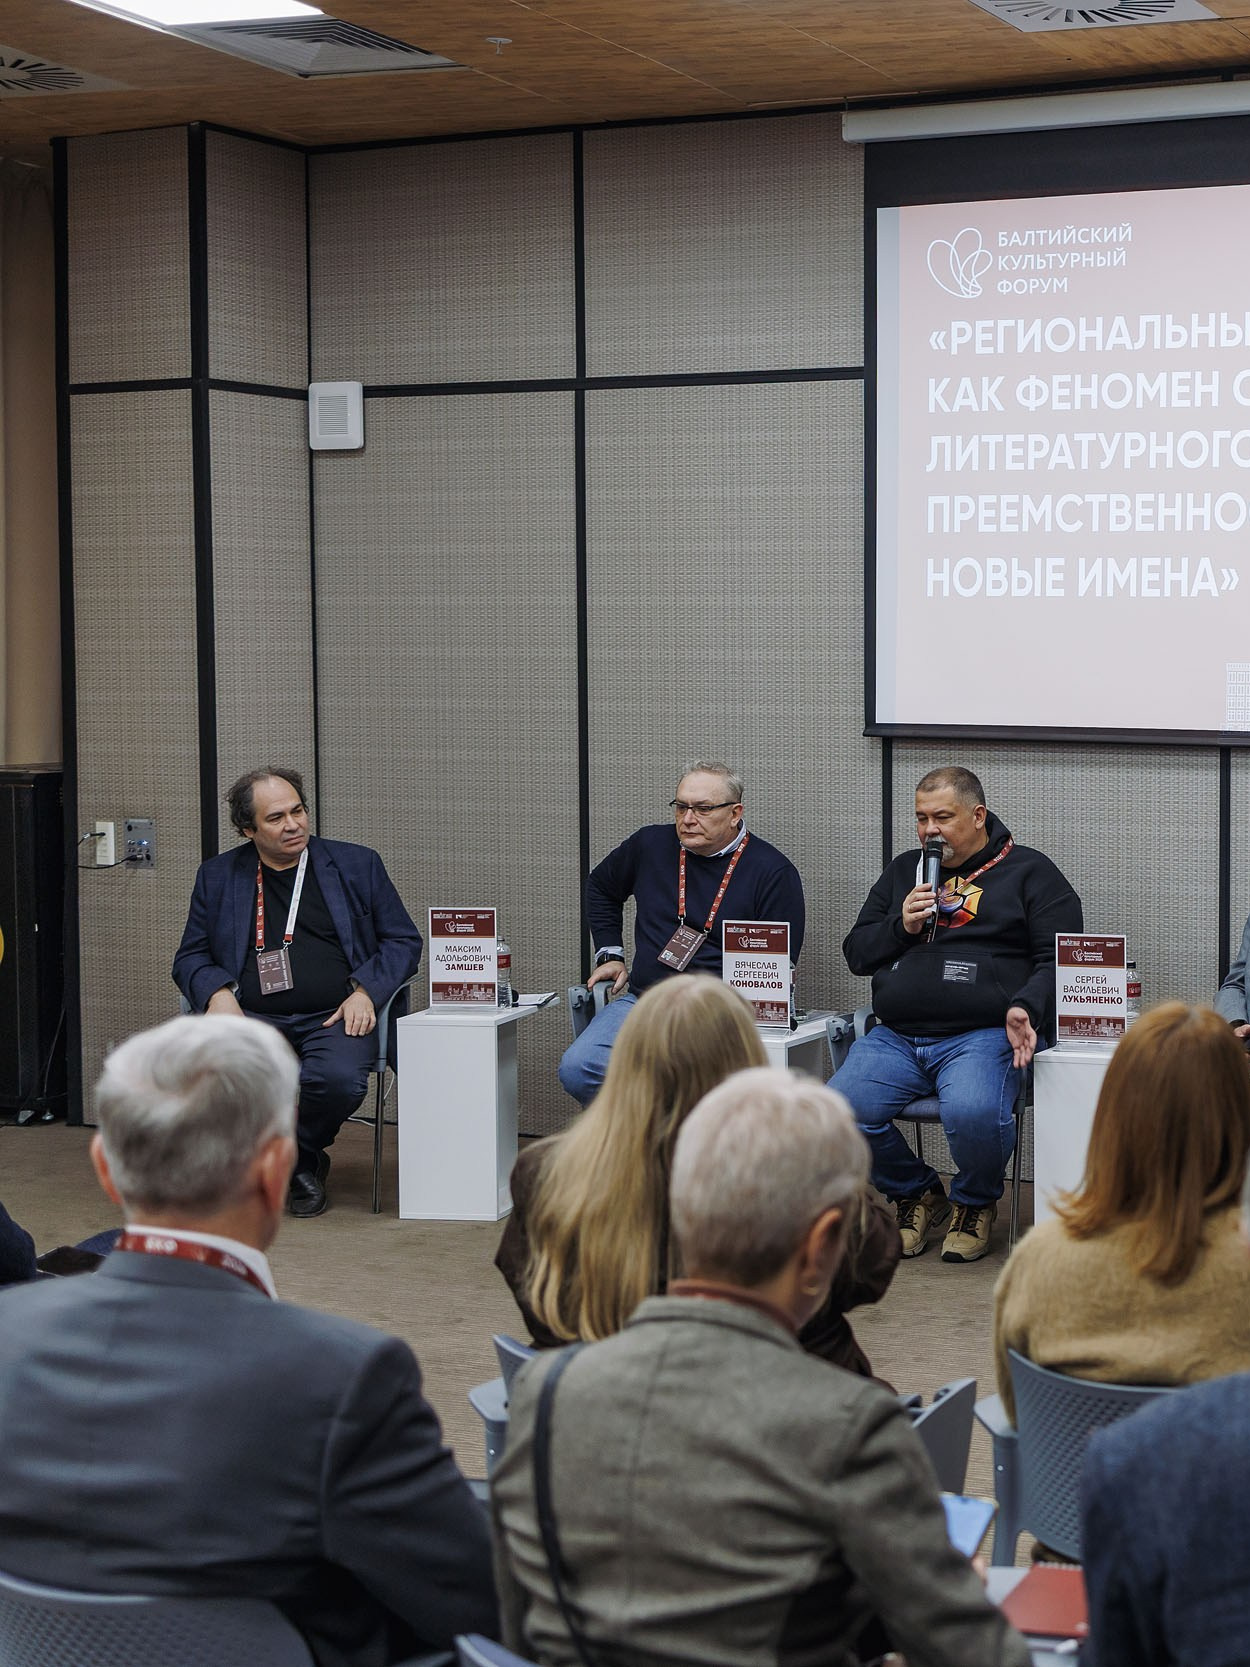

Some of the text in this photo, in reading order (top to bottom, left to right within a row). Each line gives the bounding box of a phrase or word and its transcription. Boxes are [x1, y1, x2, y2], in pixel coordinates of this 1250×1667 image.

[998, 220, 1132, 247] БАЛТИЙСКИЙ
[998, 245, 1126, 271] КУЛЬТУРНЫЙ
[998, 277, 1069, 296] ФОРУМ
[927, 375, 1004, 413] КАК
[1016, 370, 1219, 412] ФЕНОМЕН
[927, 557, 1240, 598] НОВЫЕ ИМЕНА»
[445, 945, 482, 953] МАКСИМ
[435, 954, 492, 963] АДОЛЬФОВИЧ
[445, 963, 484, 971] ЗАМШЕВ
[735, 960, 778, 970] ВЯЧЕСЛАВ
[733, 970, 779, 980] СЕРГЕЕВИЧ
[1075, 974, 1107, 985] СЕРГЕЙ
[730, 979, 783, 989] КОНОВАЛОВ
[1063, 985, 1120, 995] ВАСИЛЬЕВИЧ
[1062, 995, 1123, 1005] ЛУКЬЯНЕНКО
